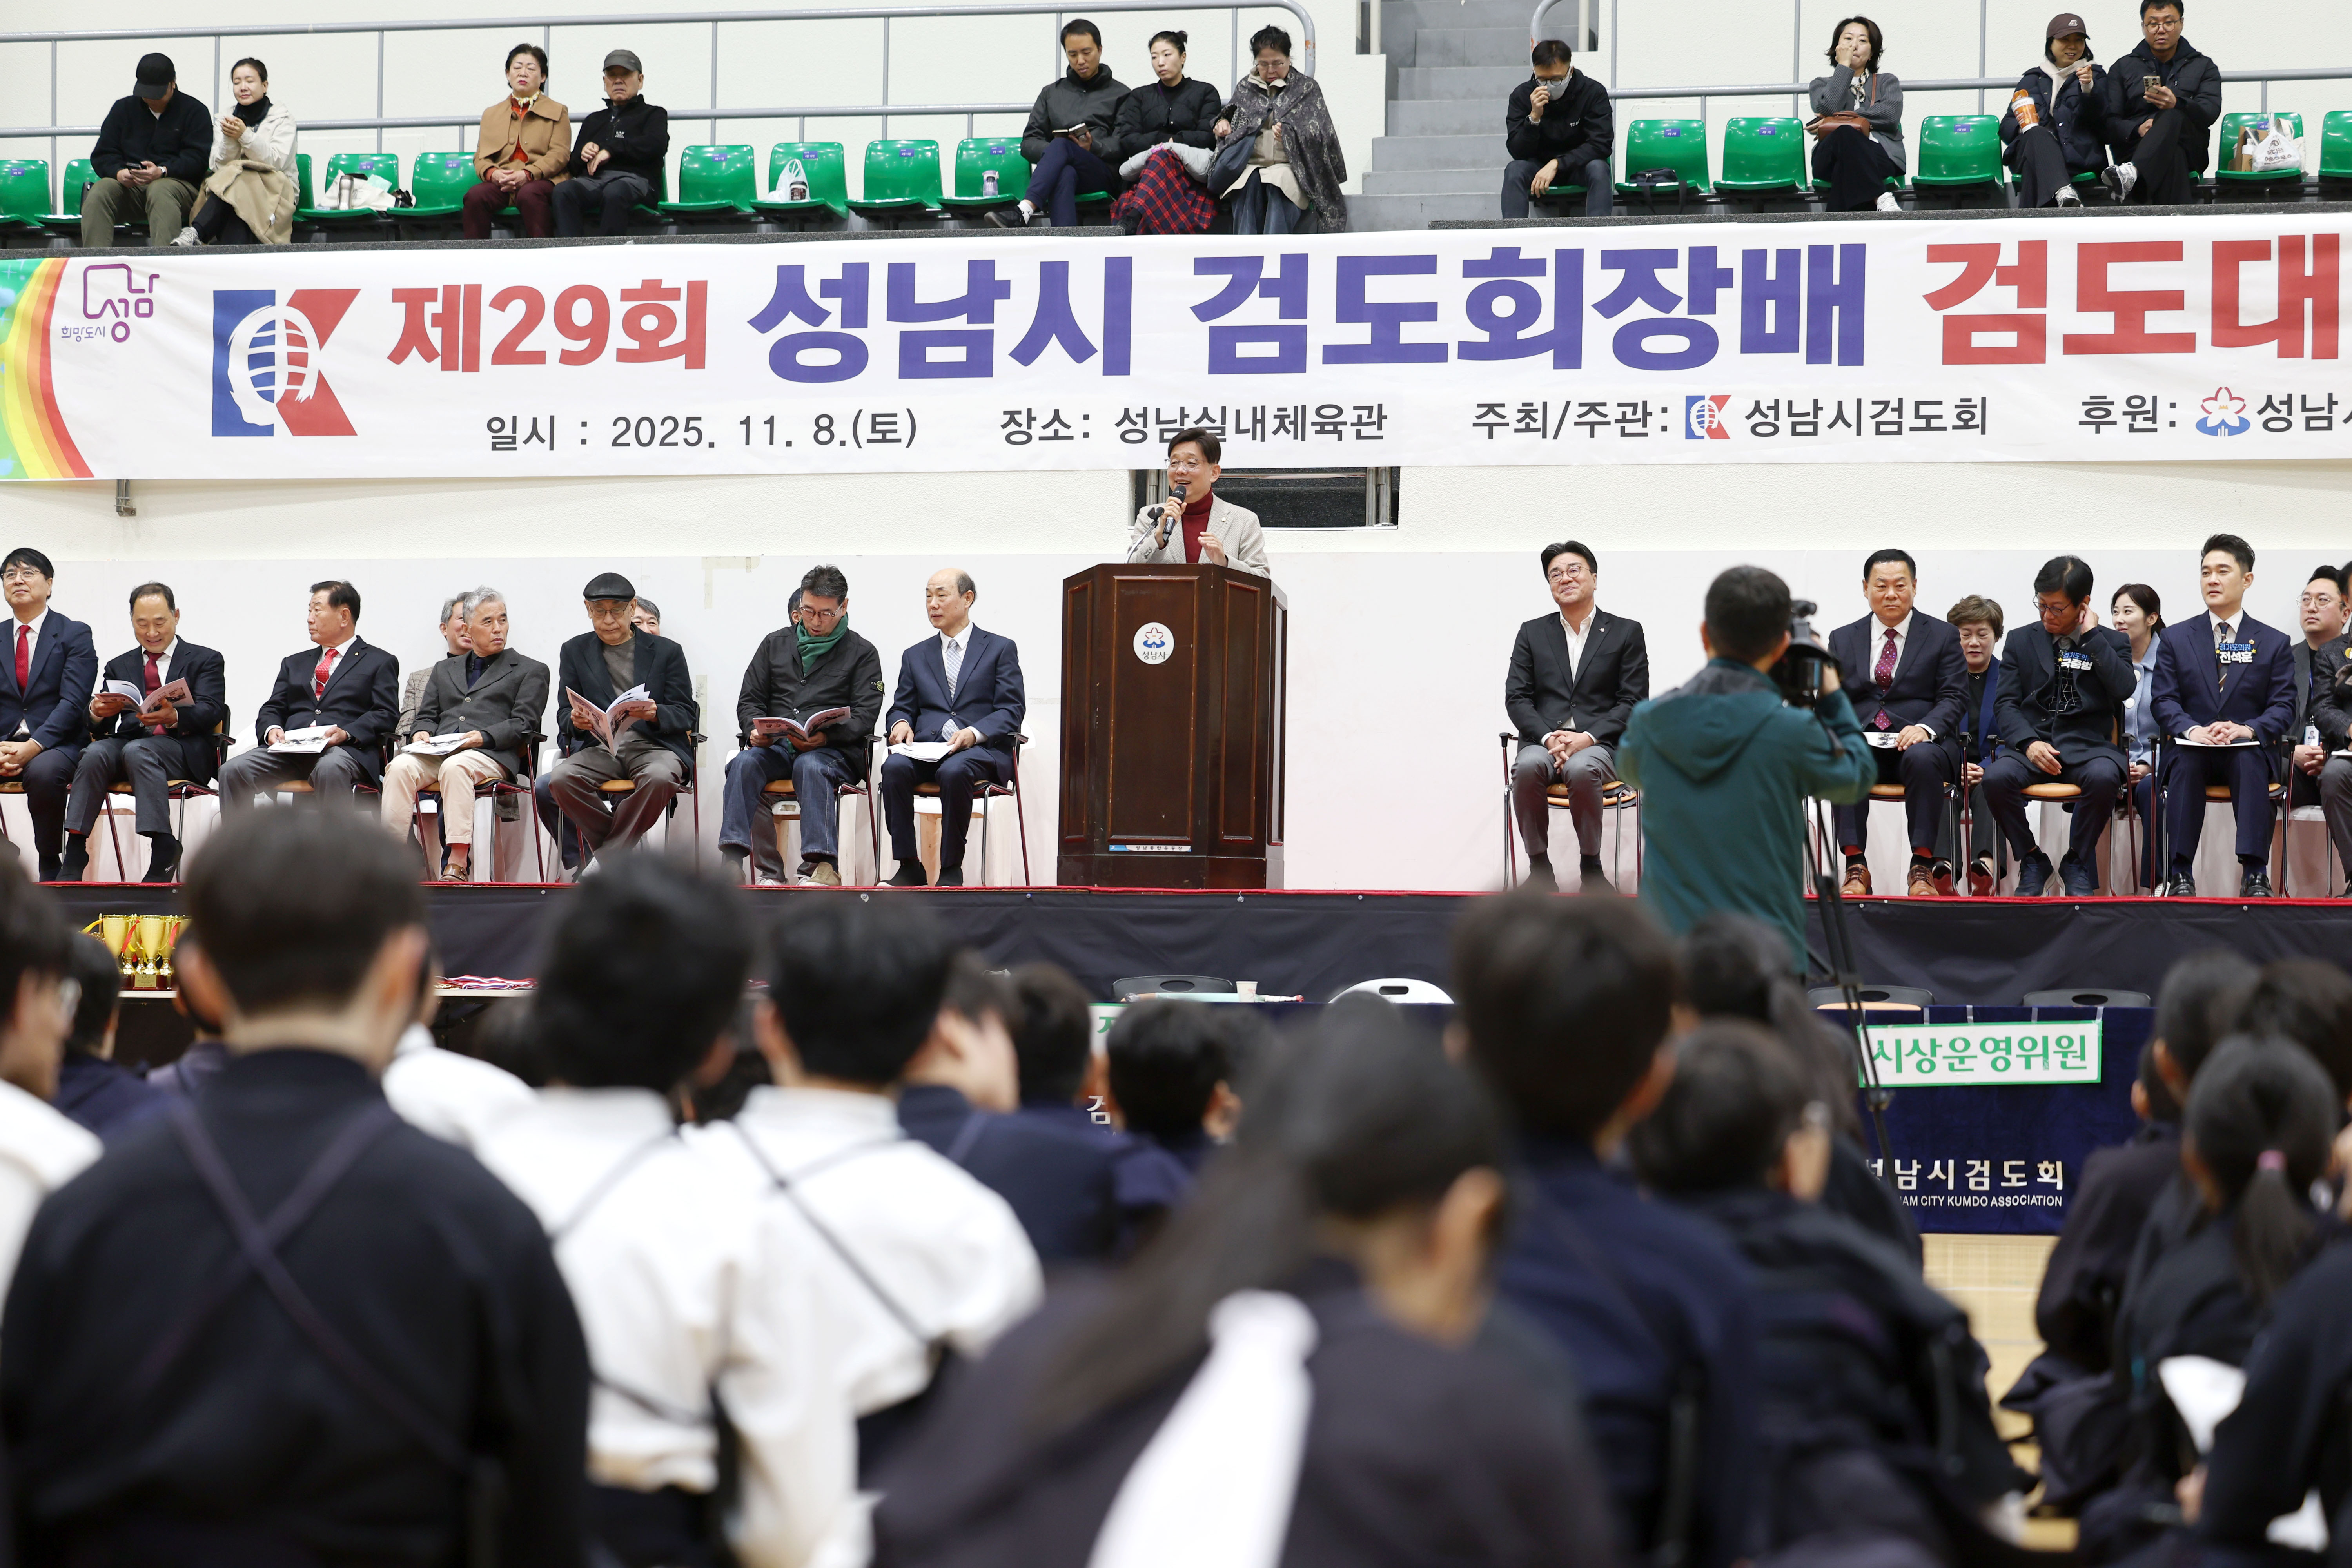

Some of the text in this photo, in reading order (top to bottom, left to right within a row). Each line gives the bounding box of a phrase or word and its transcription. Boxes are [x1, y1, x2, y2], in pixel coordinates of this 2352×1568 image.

[387, 233, 2340, 383] 제29회 성남시 검도회장배 검도대
[62, 326, 105, 342] 희망도시
[1000, 403, 1388, 445] 장소: 성남실내체육관
[1472, 400, 1668, 440] 주최/주관:
[1745, 397, 1986, 437] 성남시검도회
[2079, 392, 2352, 434] 후원: 성남
[486, 415, 556, 451] 일시
[612, 416, 715, 448] 2025.
[740, 415, 792, 447] 11.
[813, 408, 916, 449] 8.(토)
[1142, 651, 1165, 660] 성남시
[2060, 658, 2093, 671] 국중범
[2063, 652, 2091, 661] 경기도의
[2220, 651, 2253, 664] 전석훈
[1873, 1035, 2087, 1074] 시상운영위원
[1921, 1195, 1945, 1207] CITY
[1947, 1196, 1988, 1207] KUMDO
[1990, 1194, 2062, 1207] ASSOCIATION
